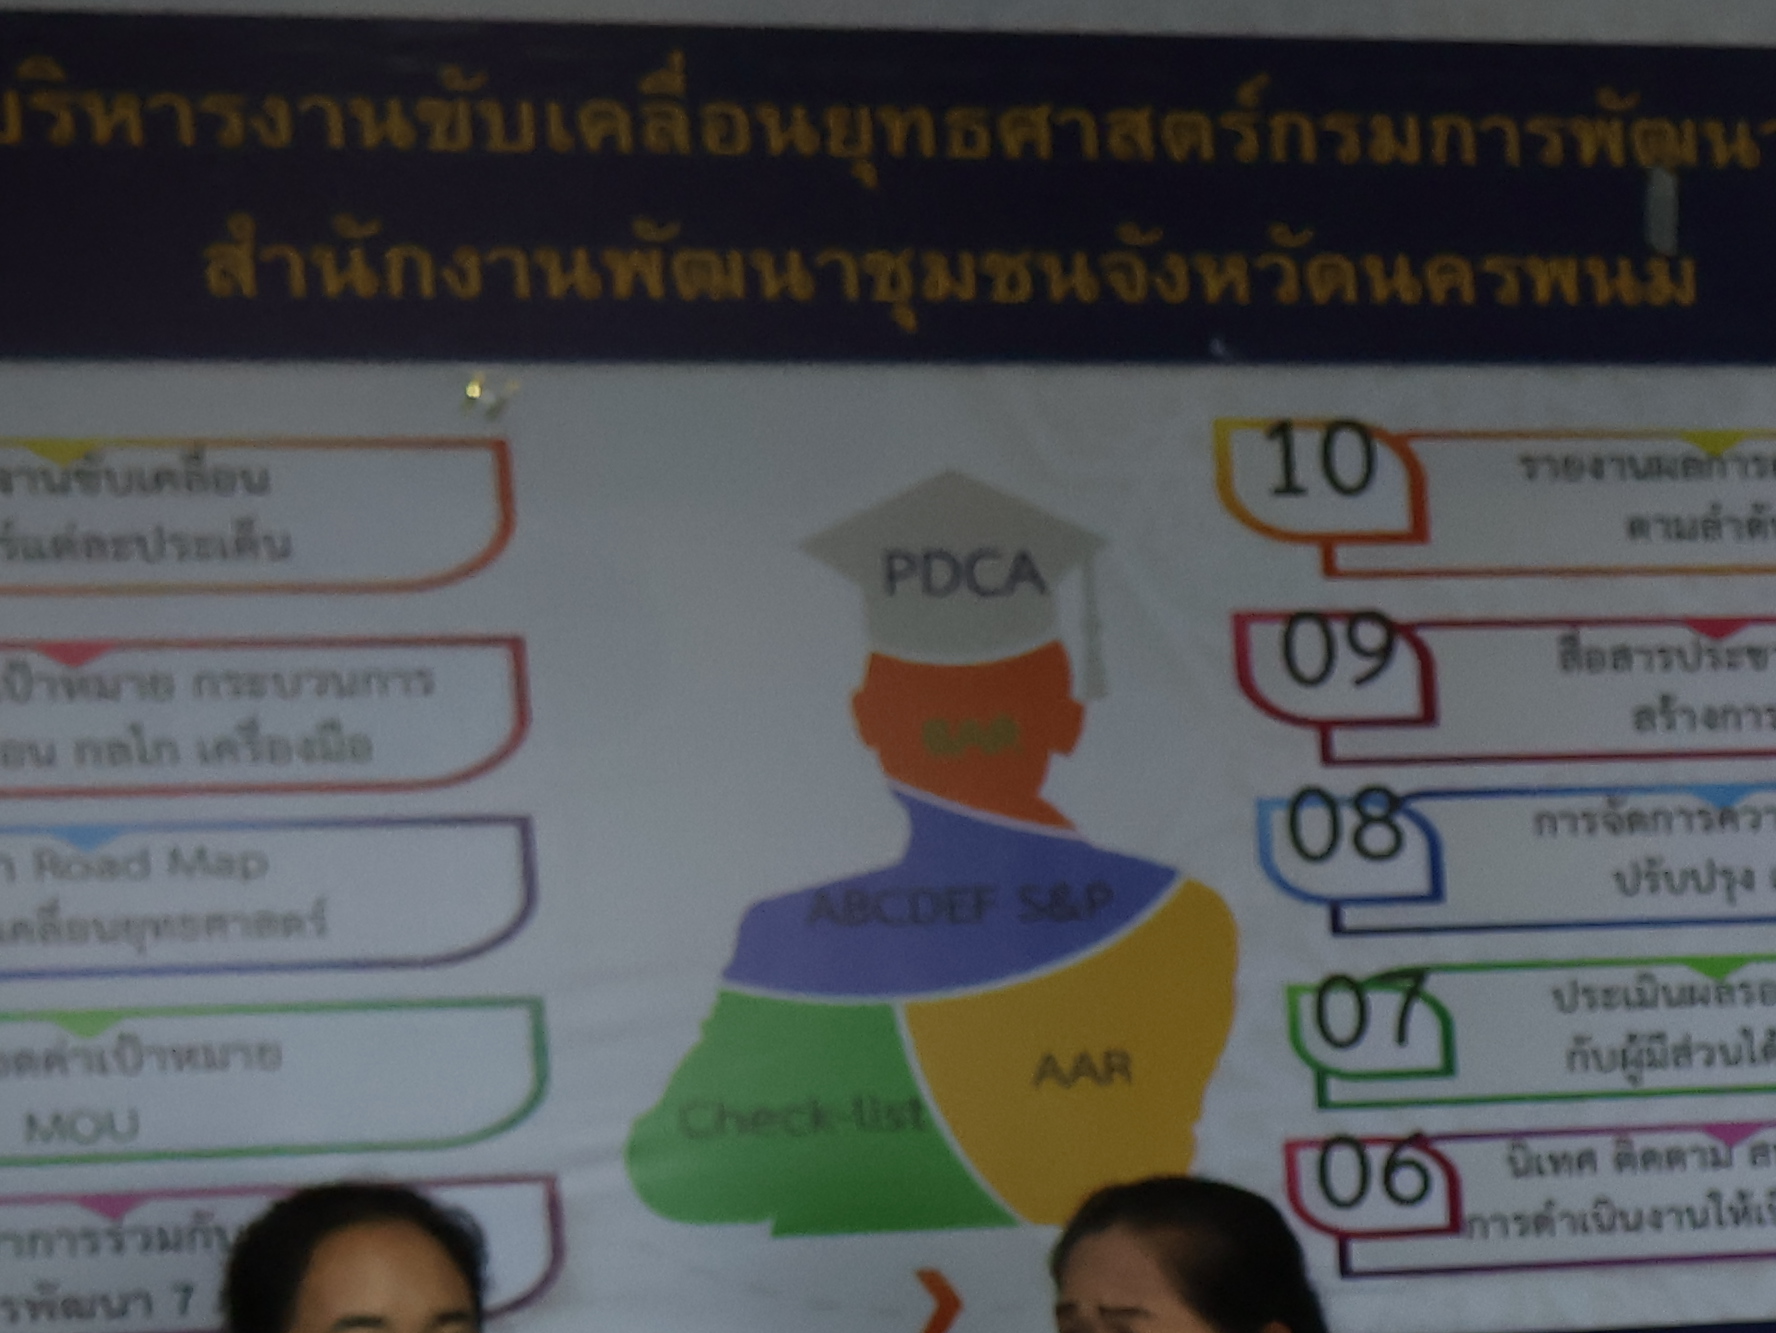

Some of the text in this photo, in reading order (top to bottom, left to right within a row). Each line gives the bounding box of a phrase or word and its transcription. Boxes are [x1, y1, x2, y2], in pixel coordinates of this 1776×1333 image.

[204, 214, 1696, 332] สำนักงานพัฒนาชุมชนจังหวัดนครพนม
[1264, 419, 1376, 498] 10
[882, 548, 1049, 601] PDCA
[1281, 609, 1398, 688] 09
[1287, 785, 1408, 861] 08
[33, 845, 152, 882] Road
[167, 845, 270, 884] Map
[809, 886, 995, 931] ABCDEF
[1316, 969, 1431, 1050] 07
[1032, 1049, 1132, 1090] AAR
[24, 1108, 141, 1145] MOU
[1316, 1131, 1433, 1208] 06
